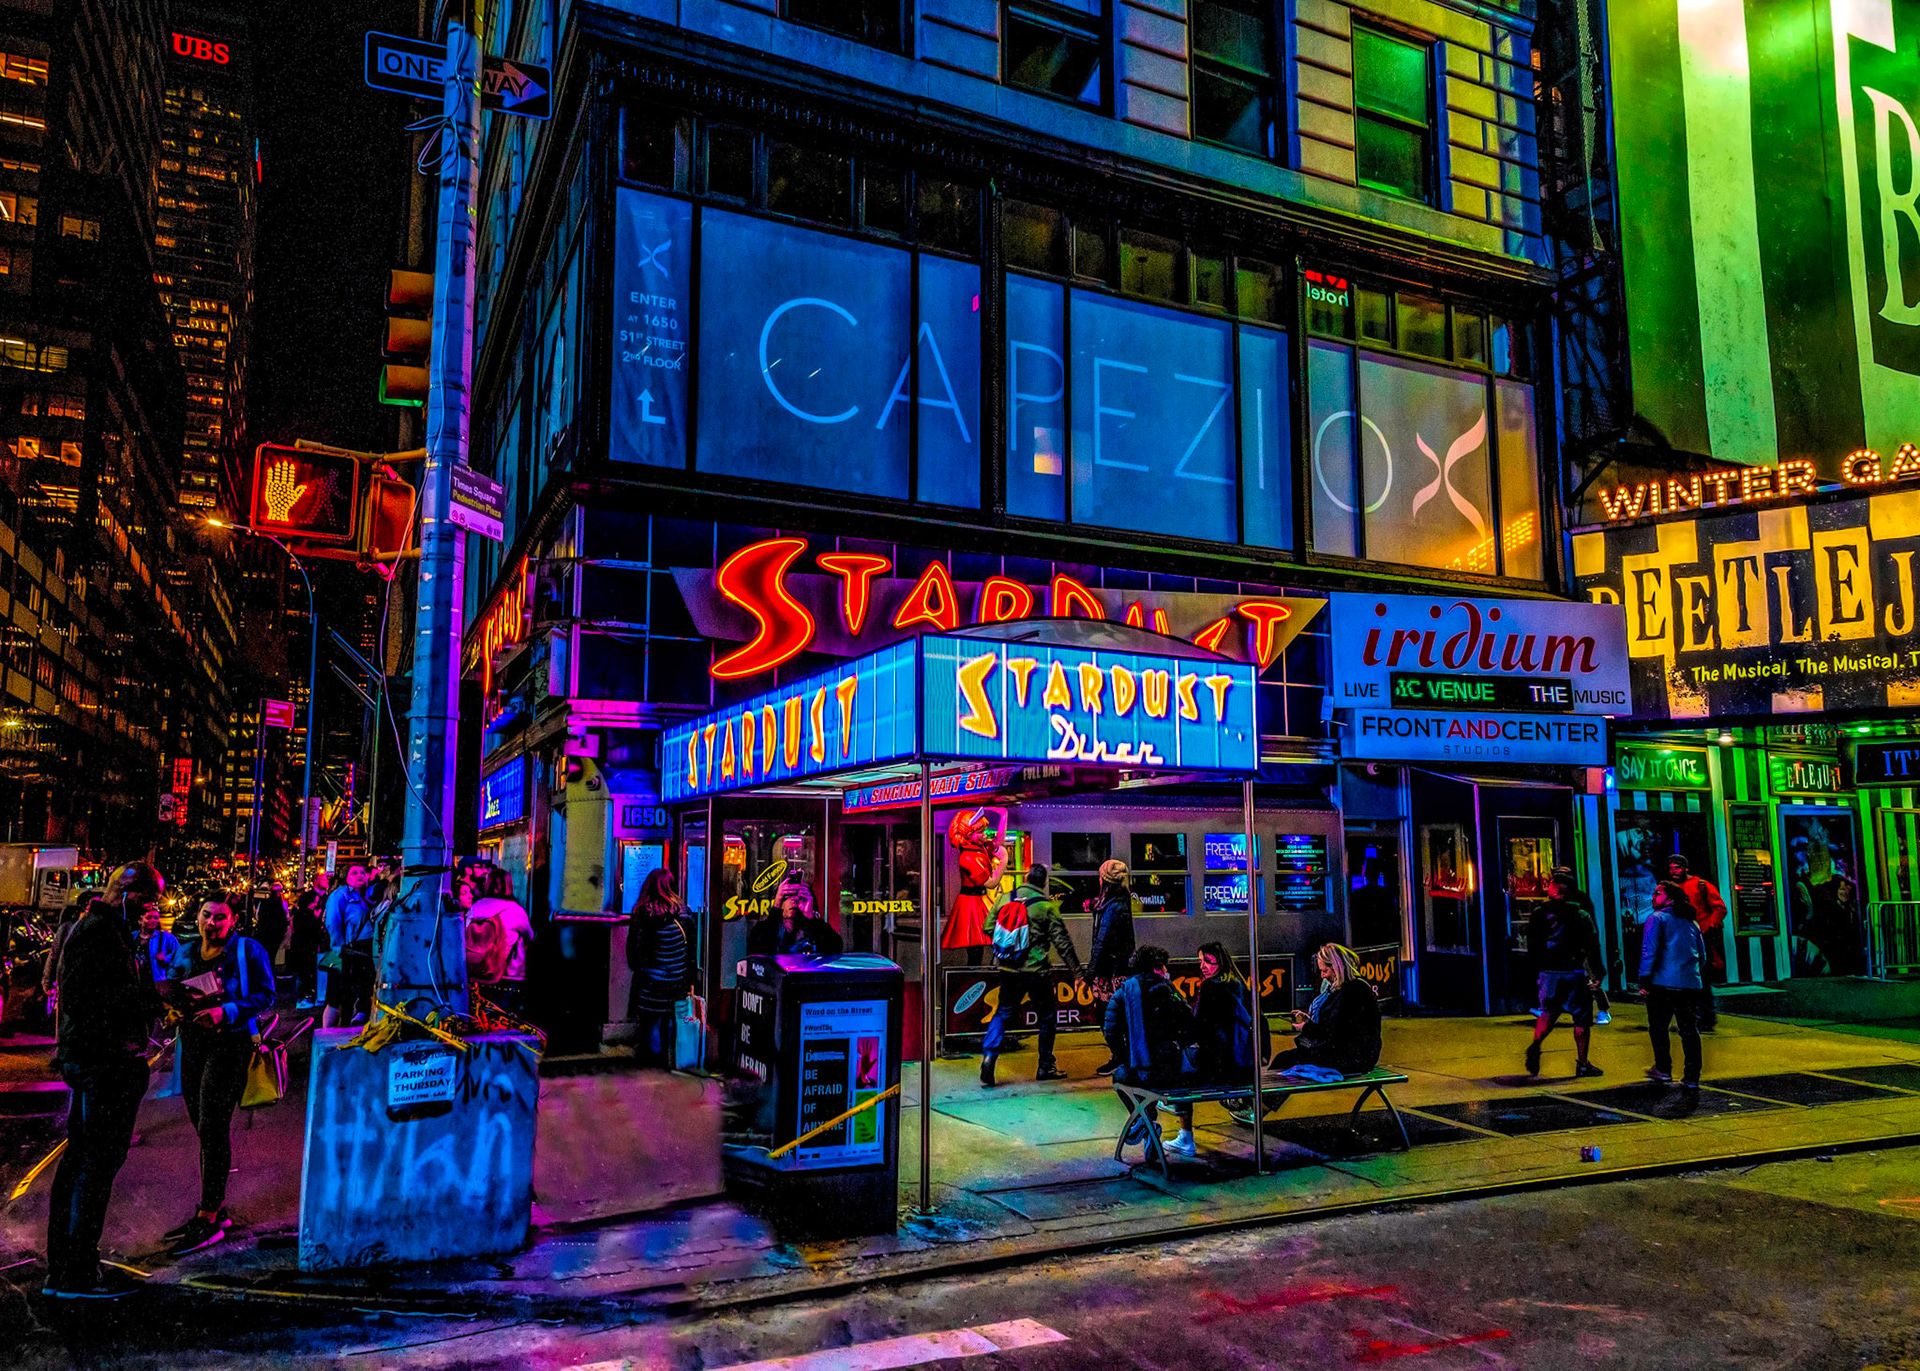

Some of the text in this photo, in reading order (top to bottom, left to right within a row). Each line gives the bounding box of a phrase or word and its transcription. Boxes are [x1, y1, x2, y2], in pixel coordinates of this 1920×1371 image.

[172, 33, 230, 65] UBS
[384, 53, 443, 82] ONE
[631, 292, 676, 310] ENTER
[644, 314, 677, 330] 1650
[646, 336, 685, 350] STREET
[643, 355, 681, 370] FLOOR
[759, 297, 1393, 514] CAPEZIO
[453, 476, 473, 494] Times
[473, 486, 496, 504] Square
[1598, 460, 1817, 520] WINTER
[1587, 544, 1915, 653] EETLEJ
[1362, 601, 1600, 673] iridium
[1692, 667, 1719, 682] The
[1796, 658, 1828, 675] The
[957, 652, 1233, 738] STARDUST
[1344, 683, 1379, 697] LIVE
[1427, 681, 1496, 701] VENUE
[1529, 685, 1569, 703] THE
[1574, 691, 1626, 705] MUSIC
[688, 674, 858, 789] STARDUST
[1047, 714, 1164, 765] Diner
[1362, 717, 1599, 743] FRONTANDCENTER
[1444, 745, 1511, 756] STUDIOS
[1023, 764, 1060, 781] FULL BAR
[1621, 755, 1646, 780] SAY
[1650, 760, 1662, 778] IT
[871, 781, 922, 804] SINGING
[965, 768, 1014, 791] STAFF
[623, 806, 666, 827] 1650
[724, 895, 775, 920] STAR
[852, 900, 914, 914] DINER
[742, 990, 763, 1015] DON'T
[805, 1008, 825, 1016] Word
[741, 1023, 751, 1044] BE
[394, 1067, 444, 1080] PARKING
[740, 1053, 767, 1084] AFRAID
[805, 1069, 818, 1080] BE
[395, 1079, 451, 1092] THURSDAY
[804, 1084, 843, 1096] AFRAID
[803, 1103, 817, 1114] OF
[803, 1121, 844, 1133] ANYNE
